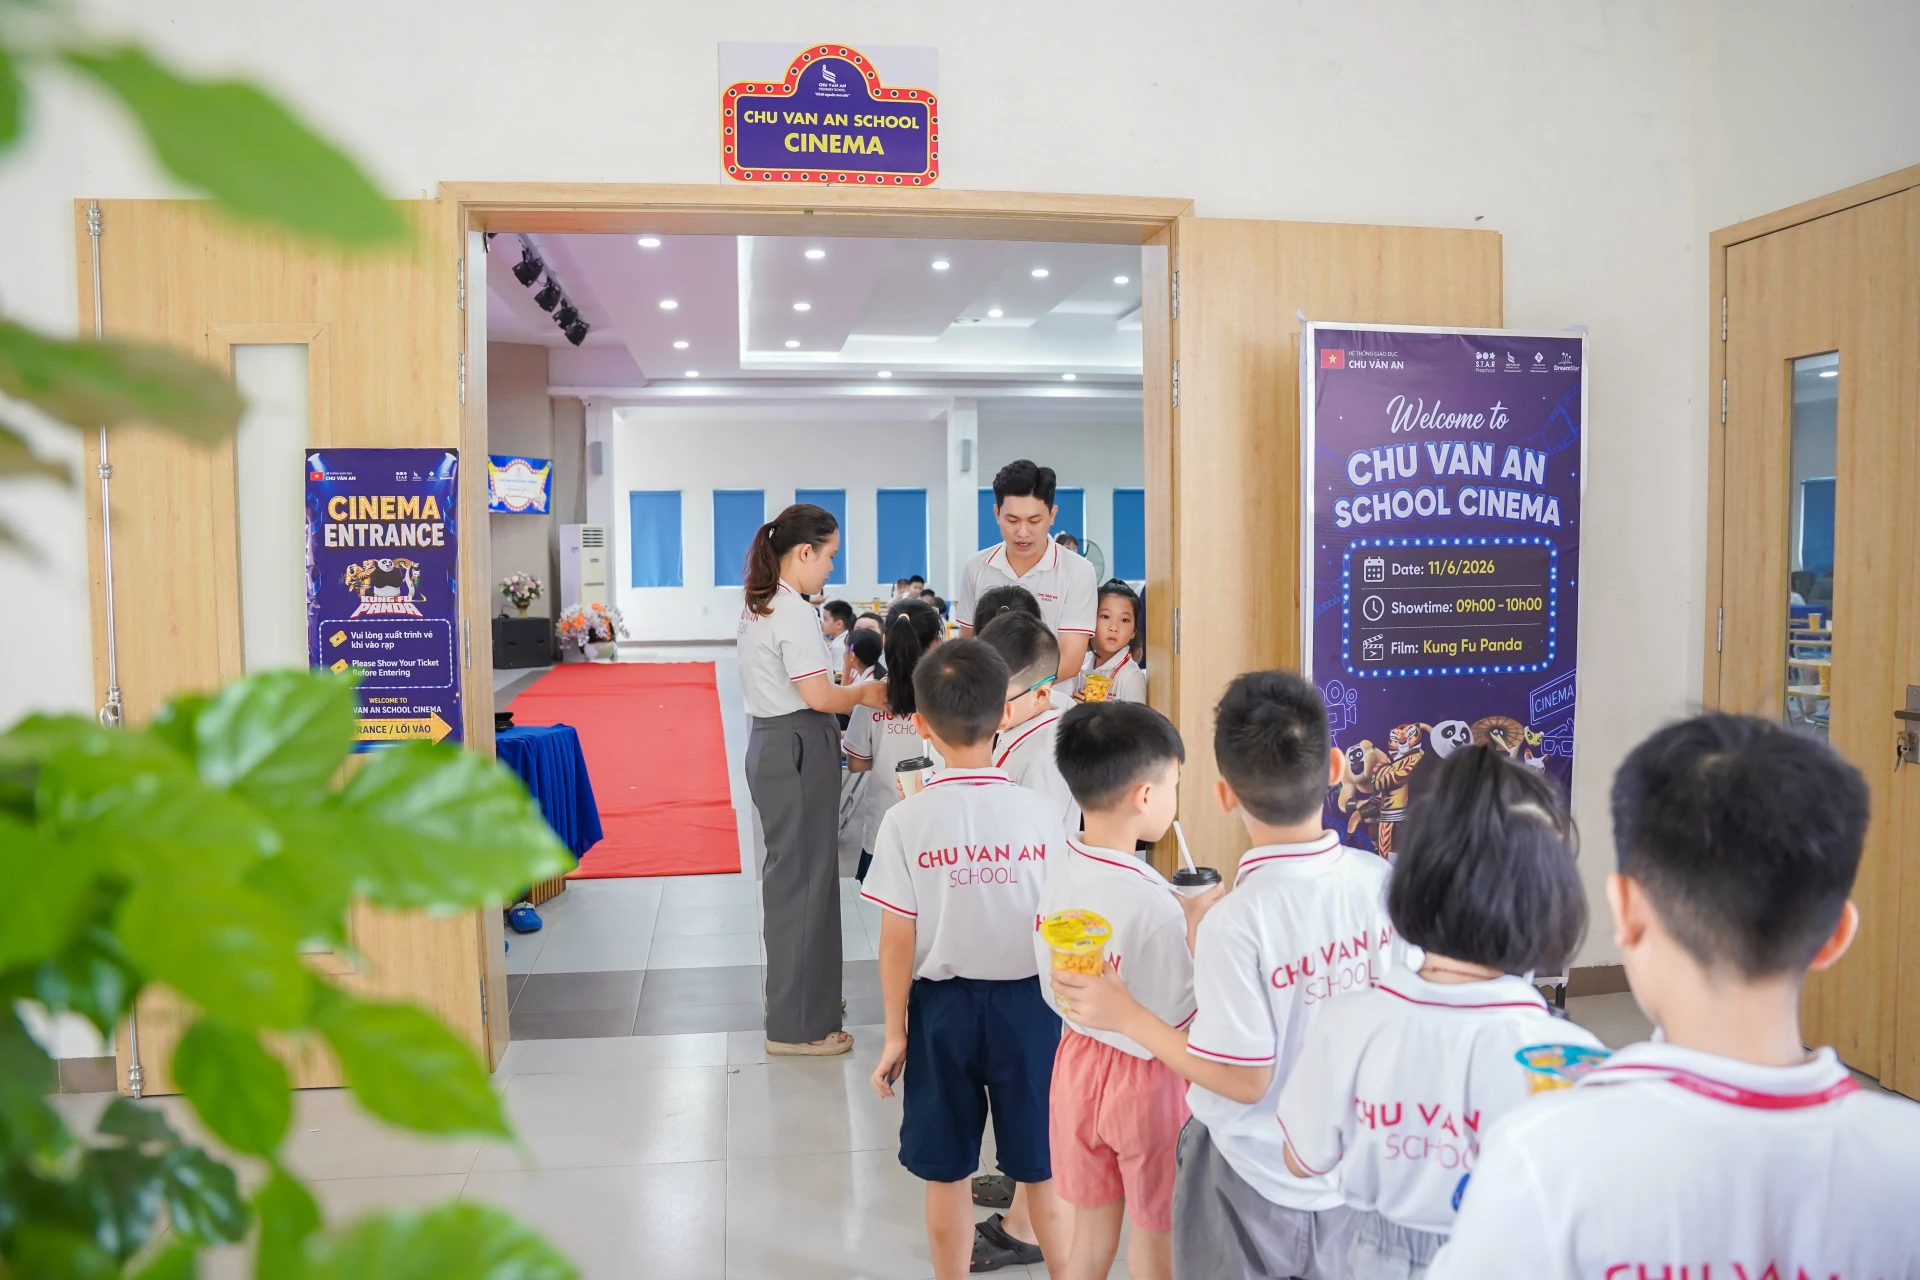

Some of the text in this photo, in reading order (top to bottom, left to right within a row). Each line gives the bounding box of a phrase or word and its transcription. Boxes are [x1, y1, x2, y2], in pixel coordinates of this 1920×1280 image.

[744, 111, 920, 129] CHU VAN AN SCHOOL
[784, 133, 885, 155] CINEMA
[1348, 359, 1404, 370] CHU VĂN AN
[1386, 395, 1509, 433] Welcome to
[1347, 442, 1547, 486] CHU VAN AN
[327, 495, 442, 521] CINEMA
[1334, 487, 1561, 528] SCHOOL CINEMA
[324, 523, 445, 547] ENTRANCE
[1391, 560, 1496, 576] Date: 11/6/2026
[350, 603, 424, 619] PANDA
[1391, 601, 1453, 614] Showtime:
[1456, 598, 1496, 613] 09h00
[1505, 597, 1542, 611] 10h00
[350, 631, 364, 639] Vui
[365, 631, 383, 641] lòng
[384, 630, 403, 639] xuất
[364, 641, 380, 649] vào
[381, 642, 395, 650] rạp
[1391, 638, 1522, 656] Film: Kung Fu Panda
[352, 658, 440, 667] Please Show Your Ticket
[378, 669, 411, 678] Entering
[1534, 684, 1575, 714] CINEMA
[872, 711, 894, 722] CHU
[356, 725, 387, 734] RANCE
[412, 723, 431, 733] VÀO
[887, 723, 916, 735] SCHO
[917, 844, 1046, 869] CHU VAN AN
[950, 867, 1018, 888] SCHOOL
[1271, 953, 1316, 989] CHU
[1320, 930, 1368, 965] VAN
[1304, 959, 1380, 1005] SCHOOL
[1417, 1102, 1480, 1138] VAN
[1385, 1133, 1480, 1173] SCHOO
